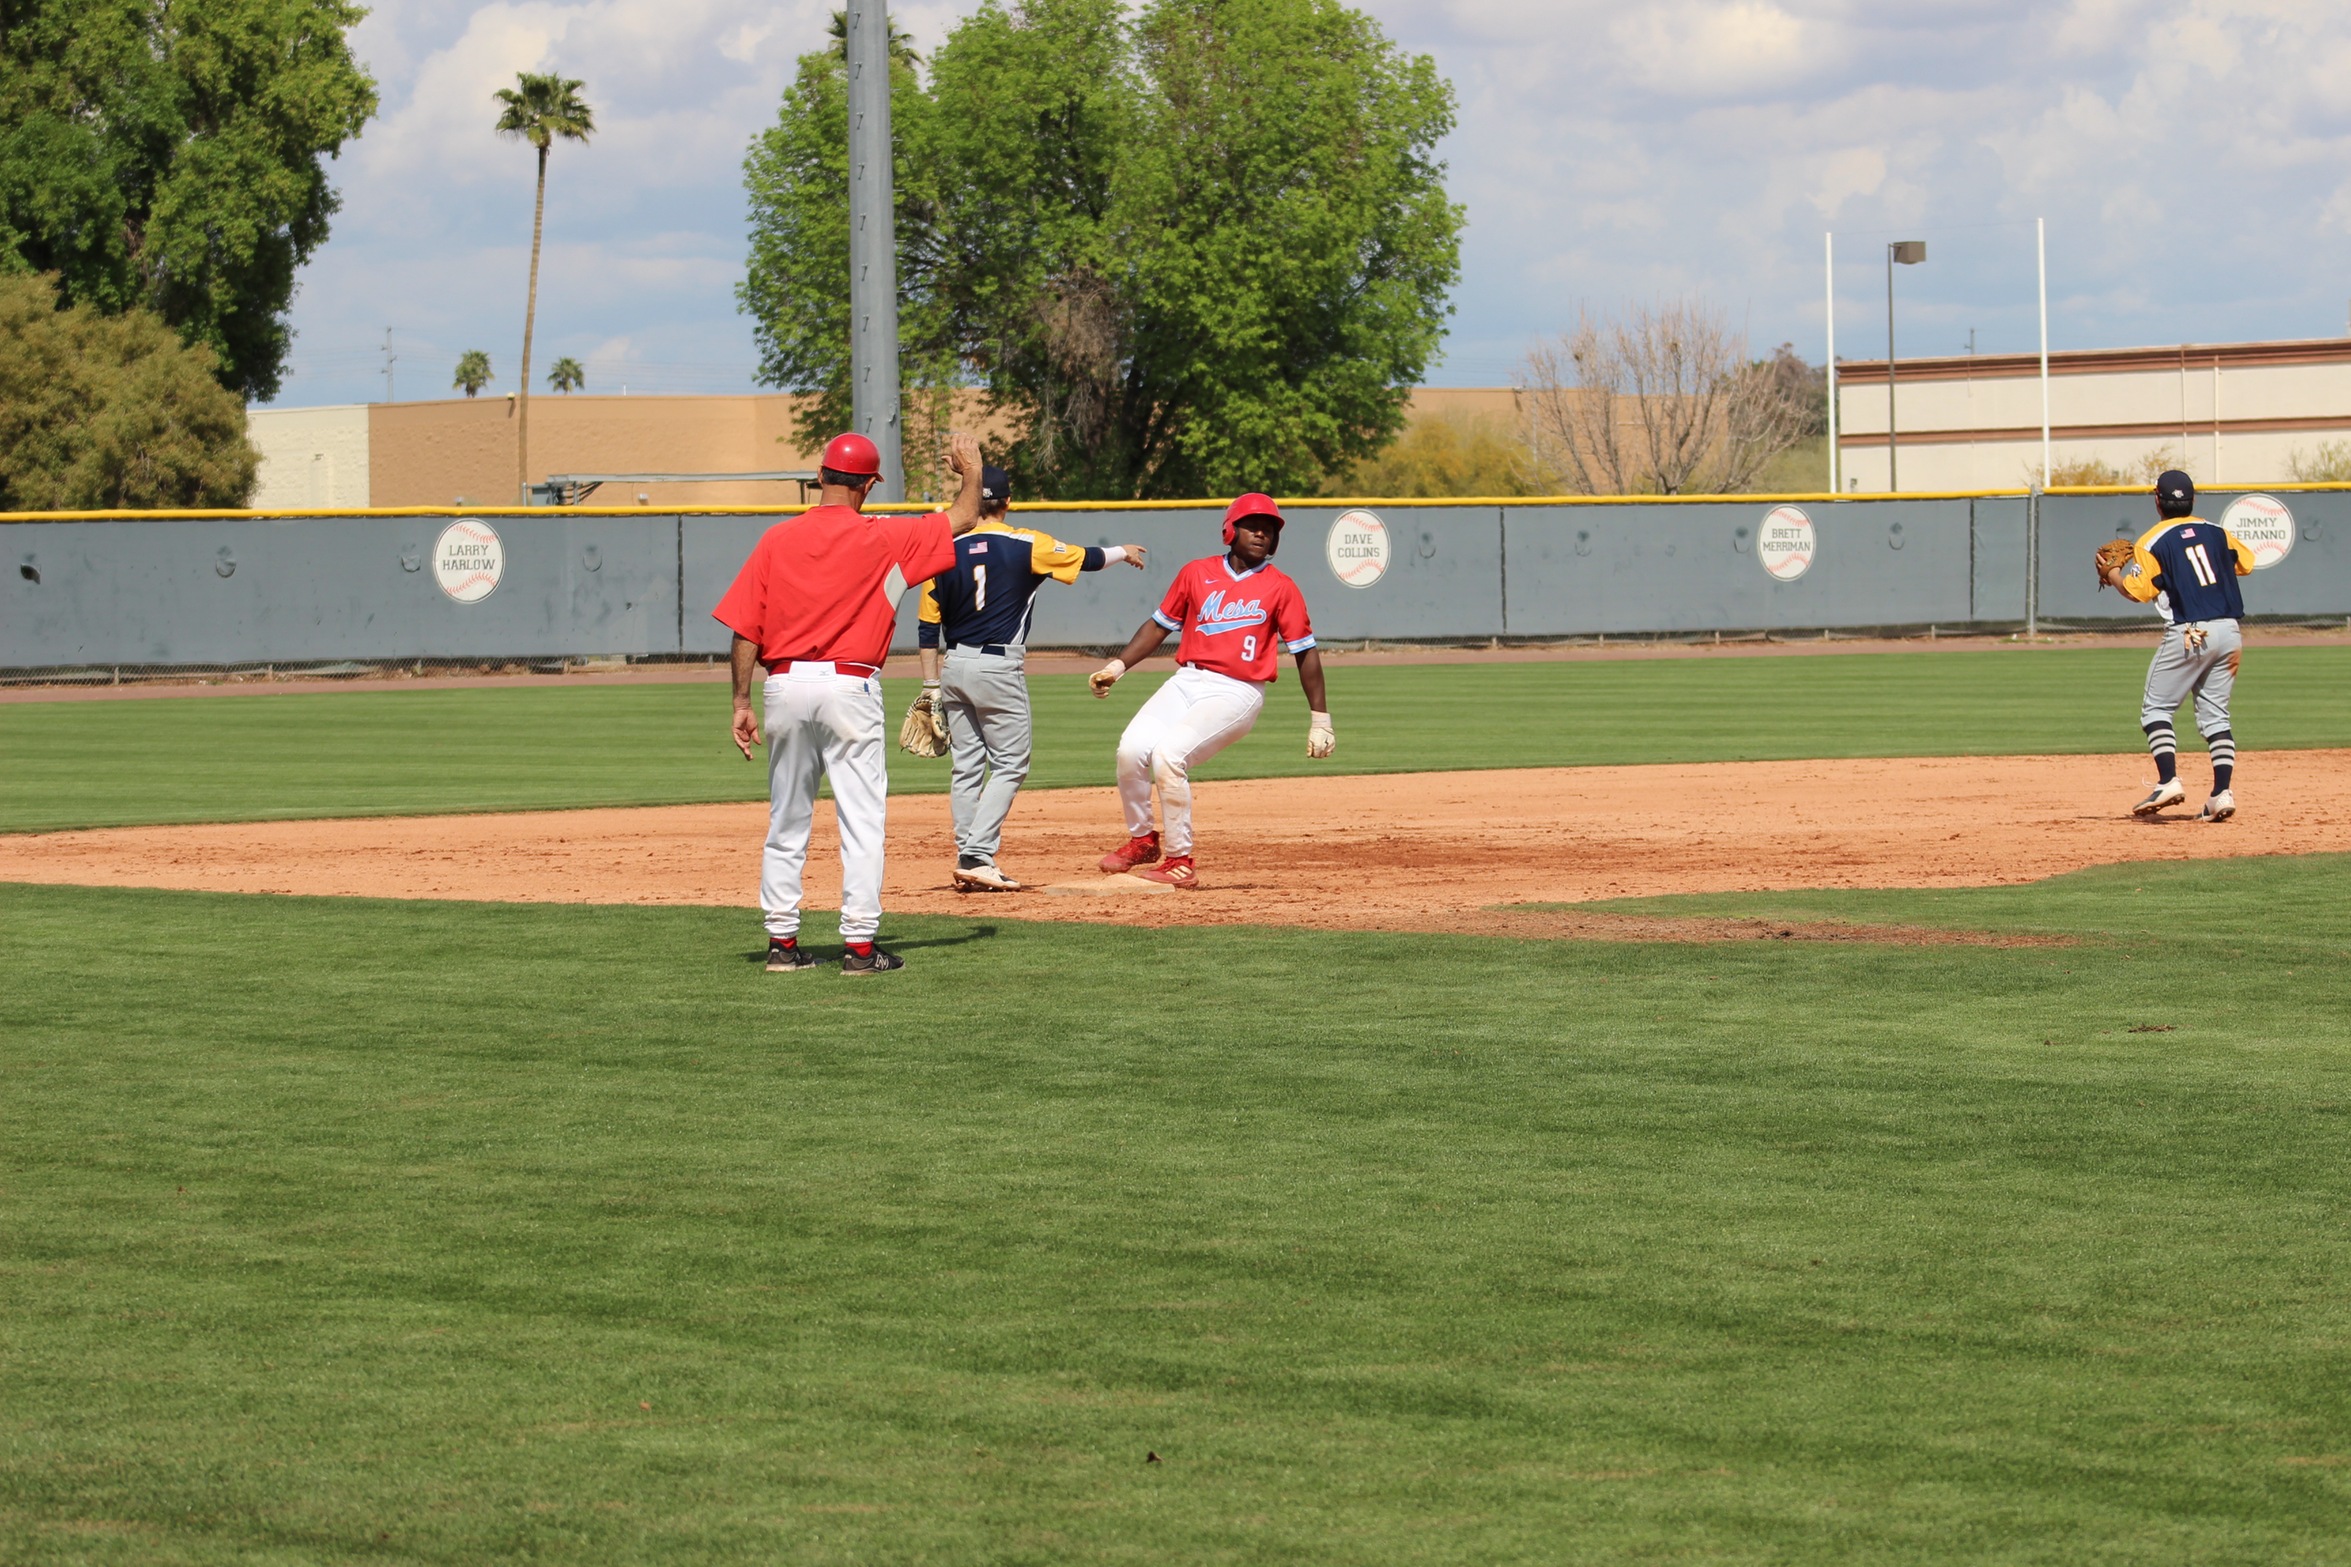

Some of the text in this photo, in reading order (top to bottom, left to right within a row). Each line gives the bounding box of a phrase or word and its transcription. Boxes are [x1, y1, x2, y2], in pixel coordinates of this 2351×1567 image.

[2236, 517, 2277, 528] JIMMY
[1772, 528, 1801, 539] BRETT
[1344, 534, 1373, 545] DAVE
[449, 544, 489, 556] LARRY
[1763, 541, 1811, 552] MERRIMAN
[1337, 547, 1380, 558] COLLINS
[442, 559, 496, 570] HARLOW
[2185, 543, 2217, 587] 11
[973, 564, 987, 611] 1
[1197, 589, 1267, 623] Mesa
[1241, 634, 1257, 662] 9
